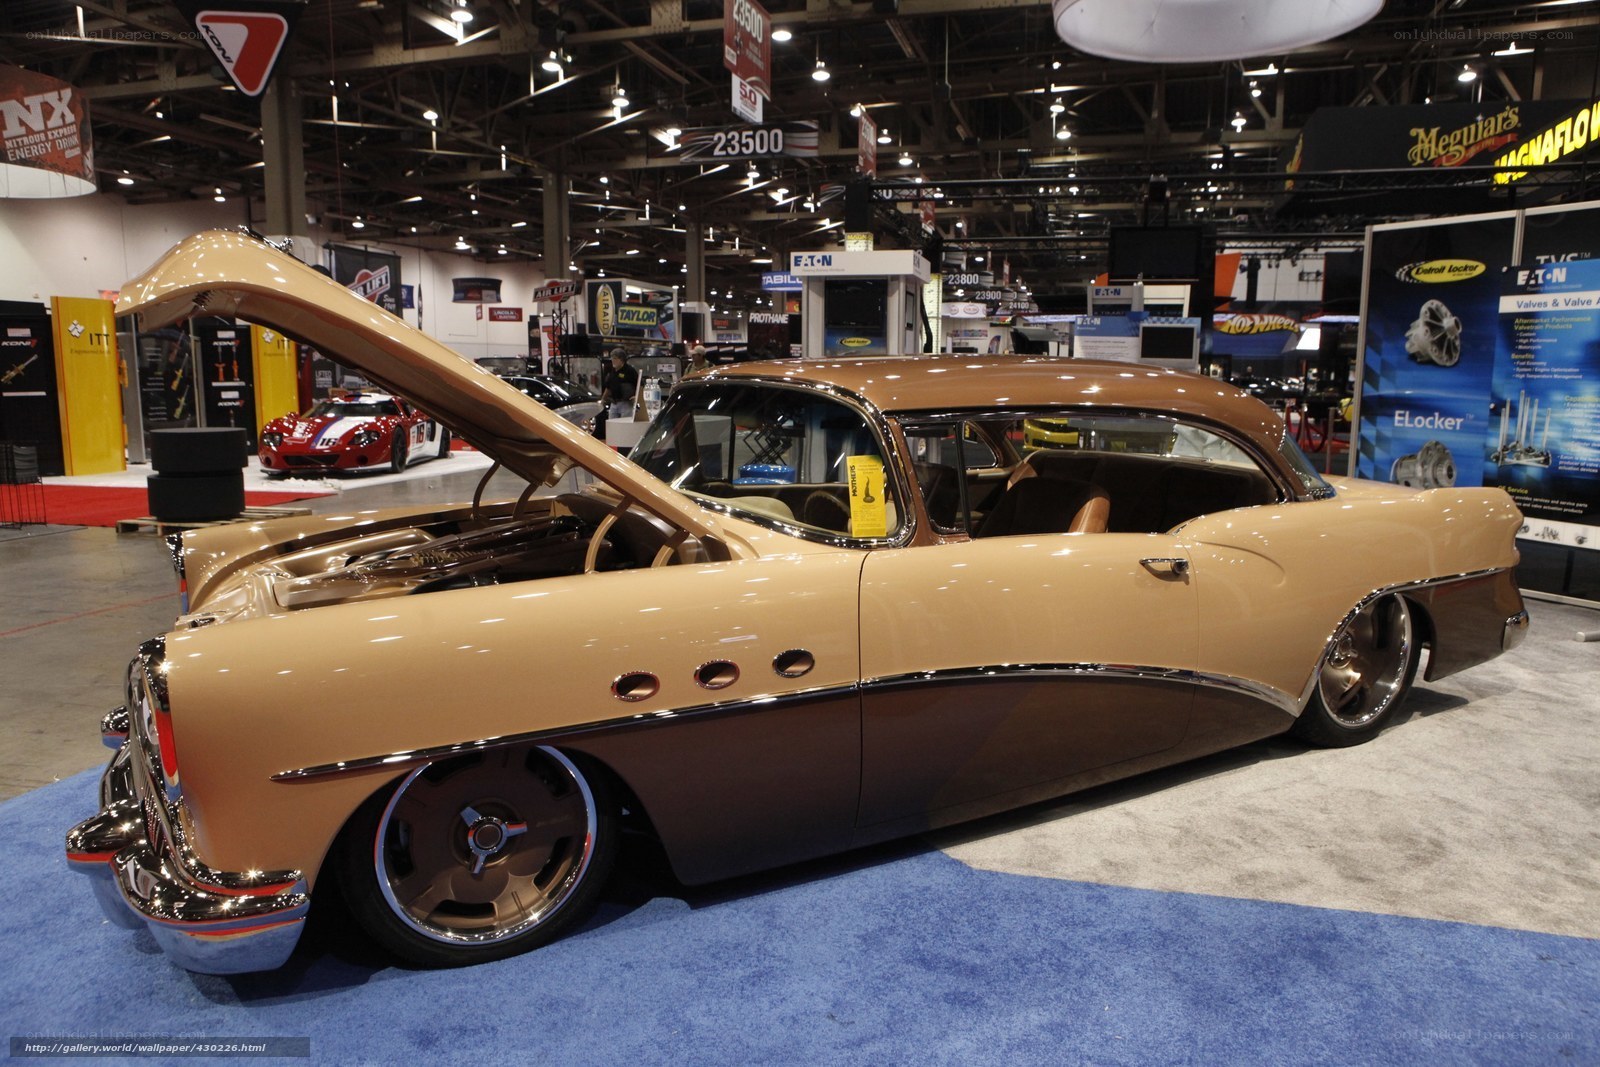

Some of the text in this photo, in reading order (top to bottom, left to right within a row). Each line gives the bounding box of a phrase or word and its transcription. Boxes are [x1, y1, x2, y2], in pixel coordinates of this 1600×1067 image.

[201, 25, 234, 63] KONI
[0, 87, 75, 139] NX
[5, 124, 77, 149] NITROUS EXPRESS
[713, 128, 783, 156] 23500
[1408, 105, 1520, 166] Meguiar's
[7, 135, 79, 161] ENERGY DRINK
[794, 255, 832, 267] EATON
[1415, 265, 1446, 275] Detroit
[1448, 264, 1479, 273] Locker
[948, 273, 979, 285] 23800
[1517, 267, 1567, 286] EATON
[366, 273, 387, 295] LIFT
[536, 285, 572, 298] AIR LIFT
[975, 291, 1002, 300] 23900
[1095, 288, 1121, 296] EATON
[1517, 300, 1548, 309] Valves
[1552, 298, 1559, 307] &
[1564, 298, 1592, 307] Valve
[619, 309, 656, 323] TAYLOR
[749, 312, 789, 324] PROTHANE
[90, 333, 110, 346] ITT
[277, 339, 291, 350] ITT
[416, 424, 425, 444] 16
[320, 438, 338, 446] 16
